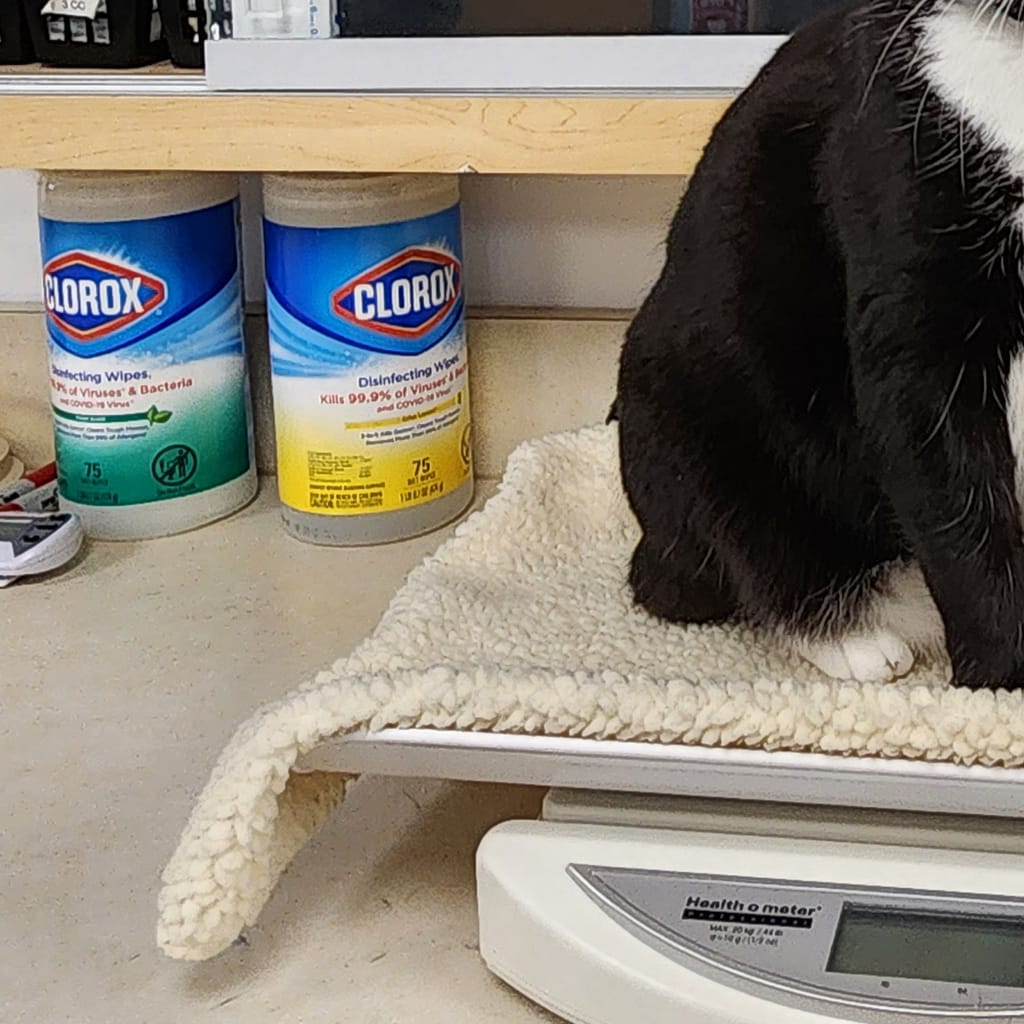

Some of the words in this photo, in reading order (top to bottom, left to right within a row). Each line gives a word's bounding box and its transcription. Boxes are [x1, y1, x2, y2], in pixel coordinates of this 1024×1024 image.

[44, 274, 145, 316] CLOROX
[353, 262, 456, 321] CLOROX
[128, 387, 137, 396] &
[140, 377, 193, 395] Bacteria
[358, 366, 432, 388] Disinfecting
[320, 394, 345, 405] Kills
[348, 390, 391, 404] 99.9%
[395, 385, 407, 399] of
[84, 462, 102, 478] 75
[412, 457, 431, 476] 75
[685, 896, 744, 912] Health
[747, 903, 760, 912] o
